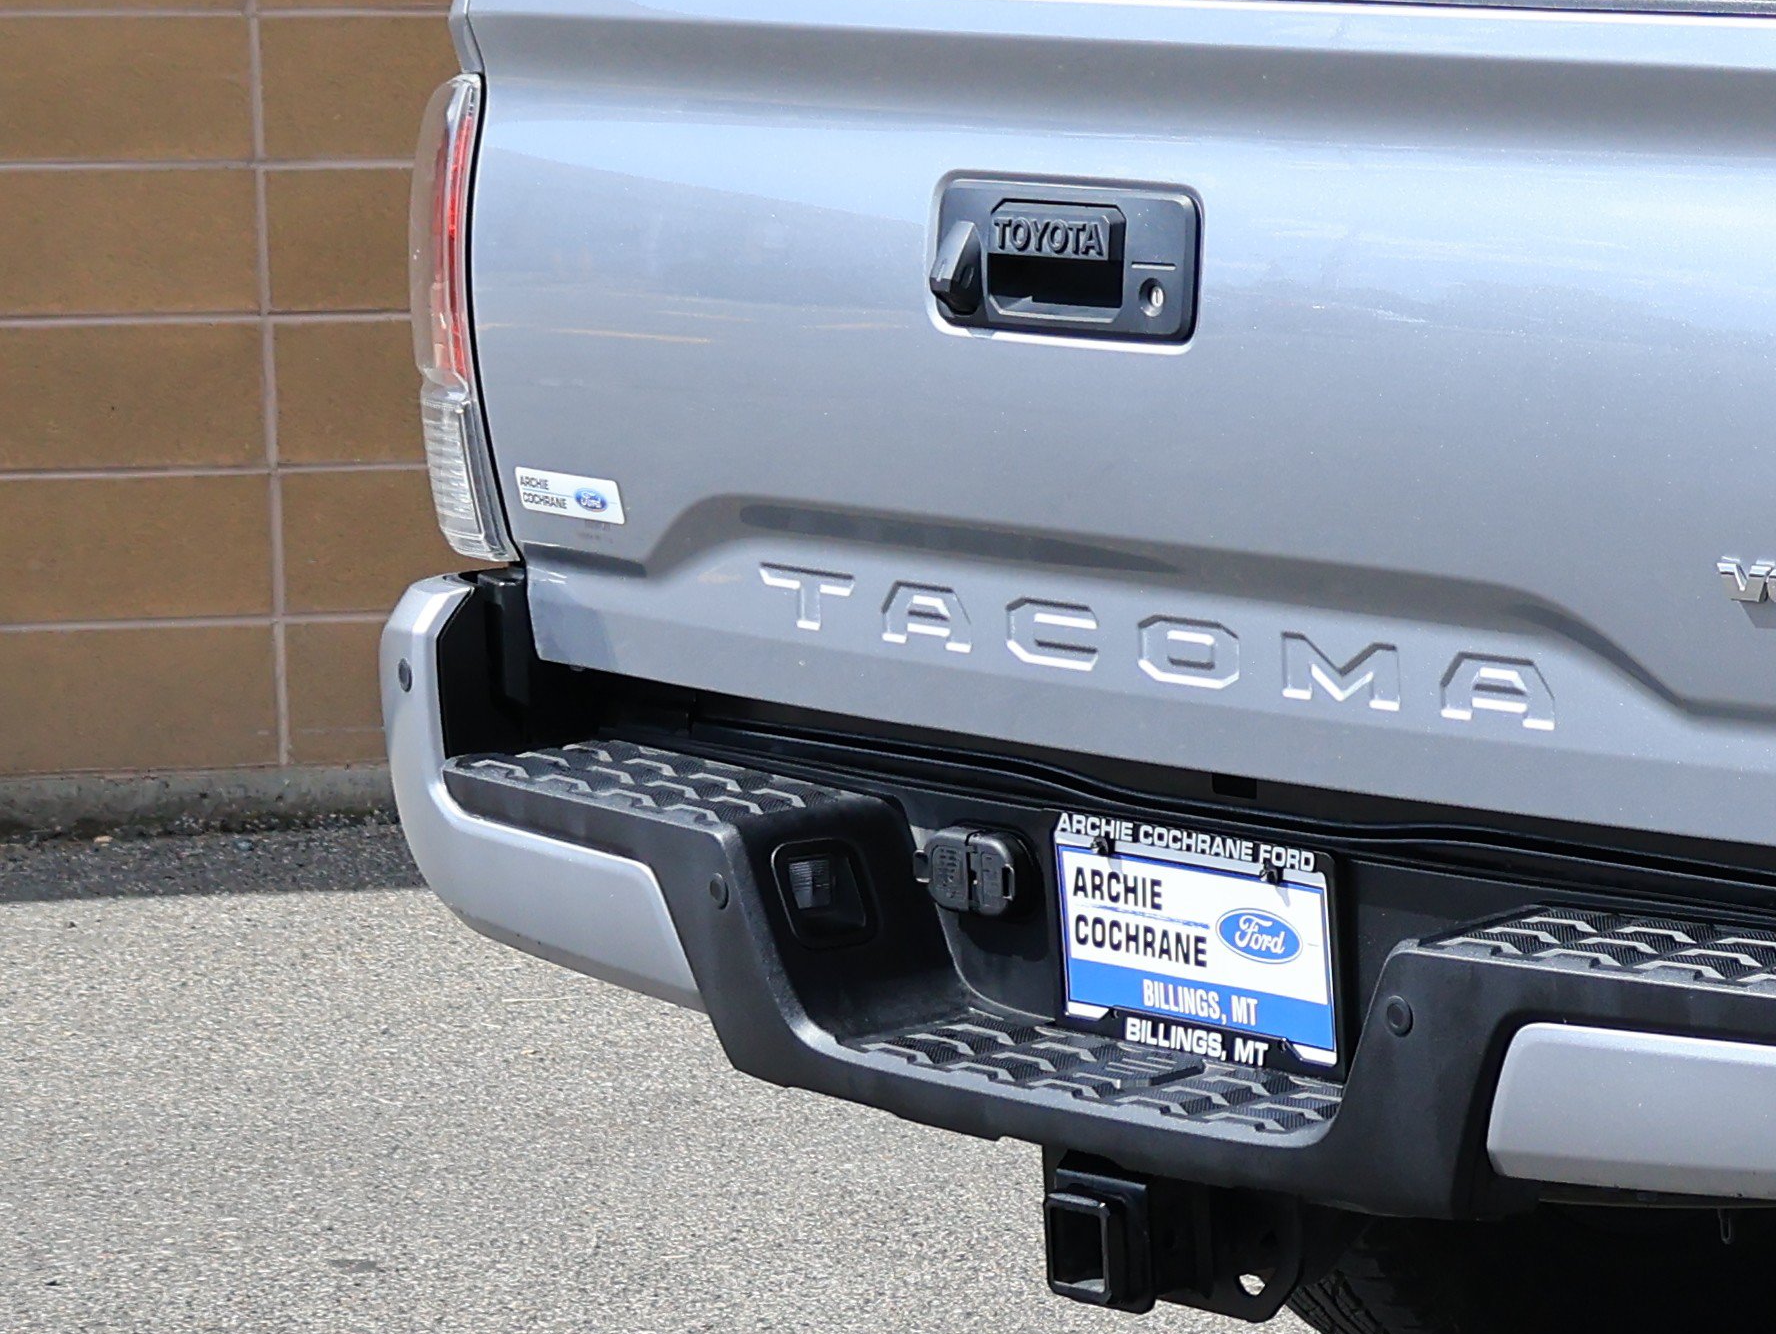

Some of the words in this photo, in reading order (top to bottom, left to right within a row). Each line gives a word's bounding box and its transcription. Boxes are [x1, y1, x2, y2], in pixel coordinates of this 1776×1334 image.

[993, 216, 1104, 257] TOYOTA
[520, 475, 549, 490] ARCHIE
[522, 492, 568, 509] COCHRANE
[580, 492, 603, 509] Ford
[758, 561, 1556, 731] TACOMA
[1056, 812, 1134, 842] ARCHIE
[1139, 825, 1254, 865] COCHRANE
[1258, 844, 1316, 873] FORD
[1072, 866, 1163, 911] ARCHIE
[1074, 913, 1208, 968] COCHRANE
[1233, 914, 1286, 955] Ford
[1142, 978, 1227, 1025] BILLINGS,
[1231, 994, 1259, 1027] MT
[1124, 1017, 1228, 1061] BILLINGS,
[1233, 1041, 1269, 1067] MT
